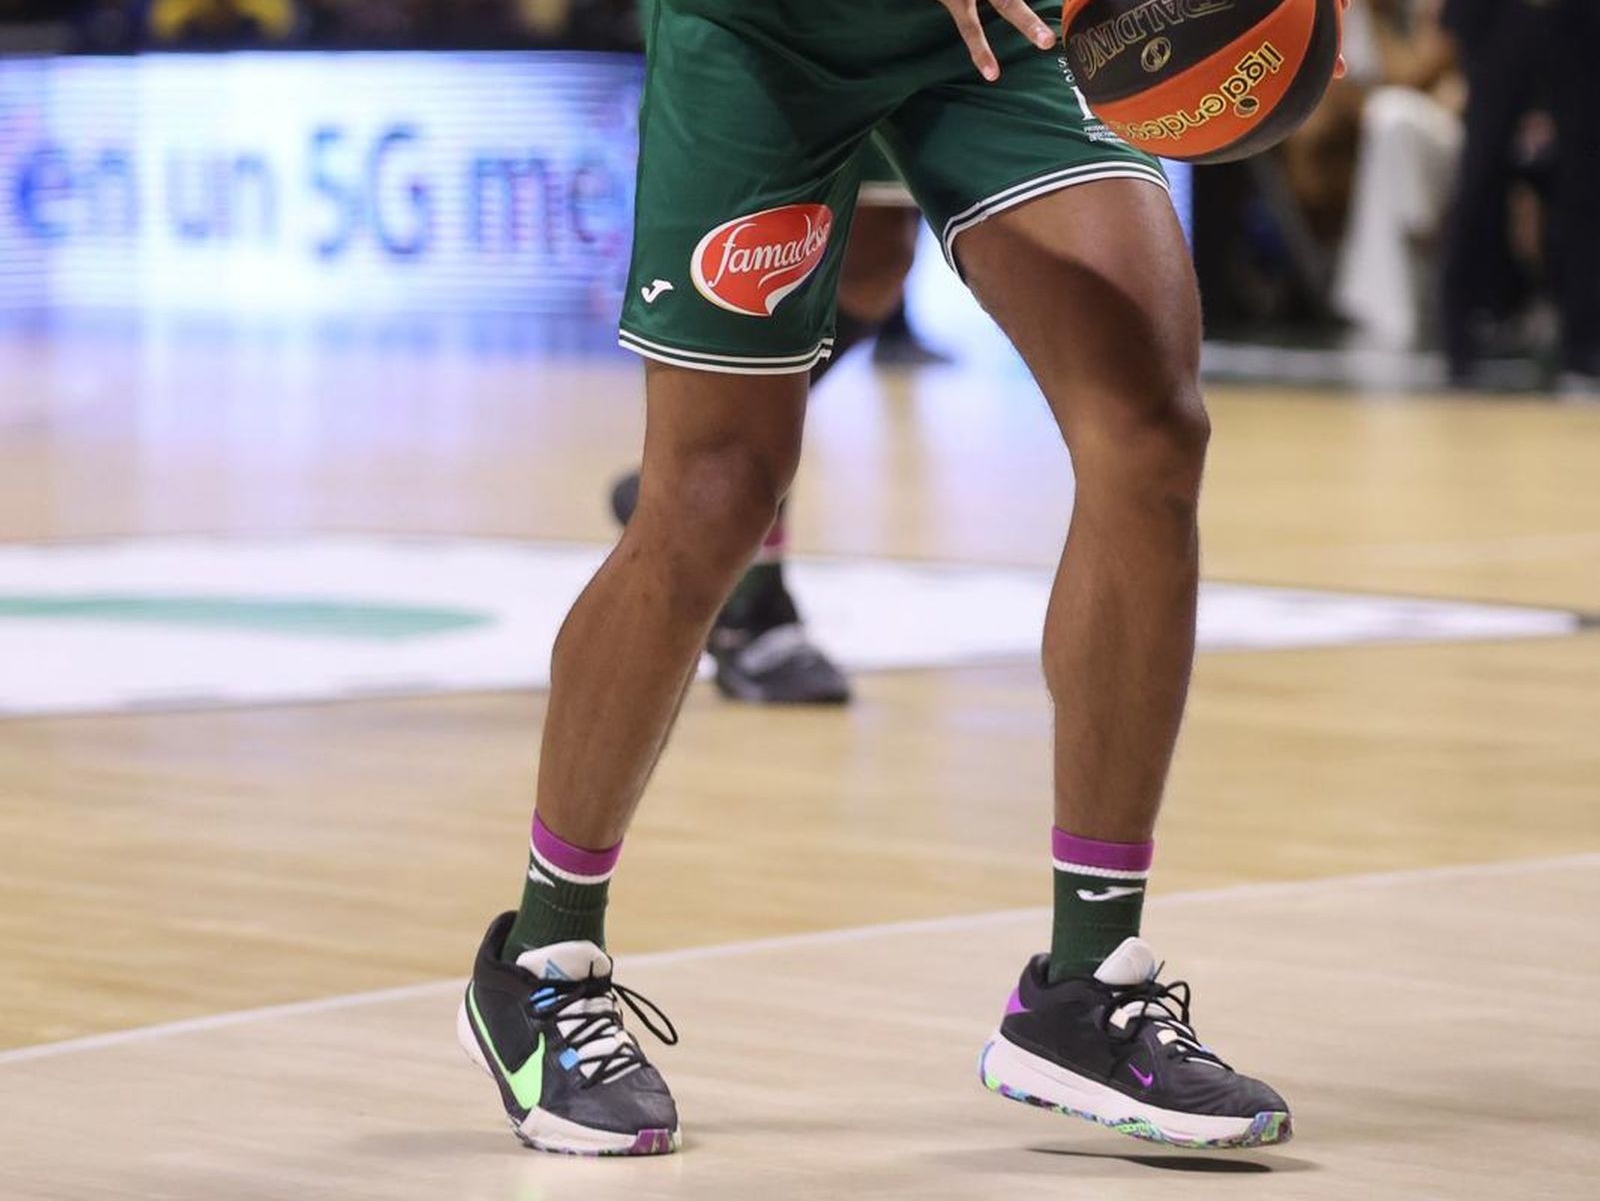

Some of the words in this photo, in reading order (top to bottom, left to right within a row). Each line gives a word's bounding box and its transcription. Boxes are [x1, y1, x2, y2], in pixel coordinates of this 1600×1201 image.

[1221, 41, 1285, 102] liga
[166, 147, 278, 245] un
[308, 119, 434, 261] 5G
